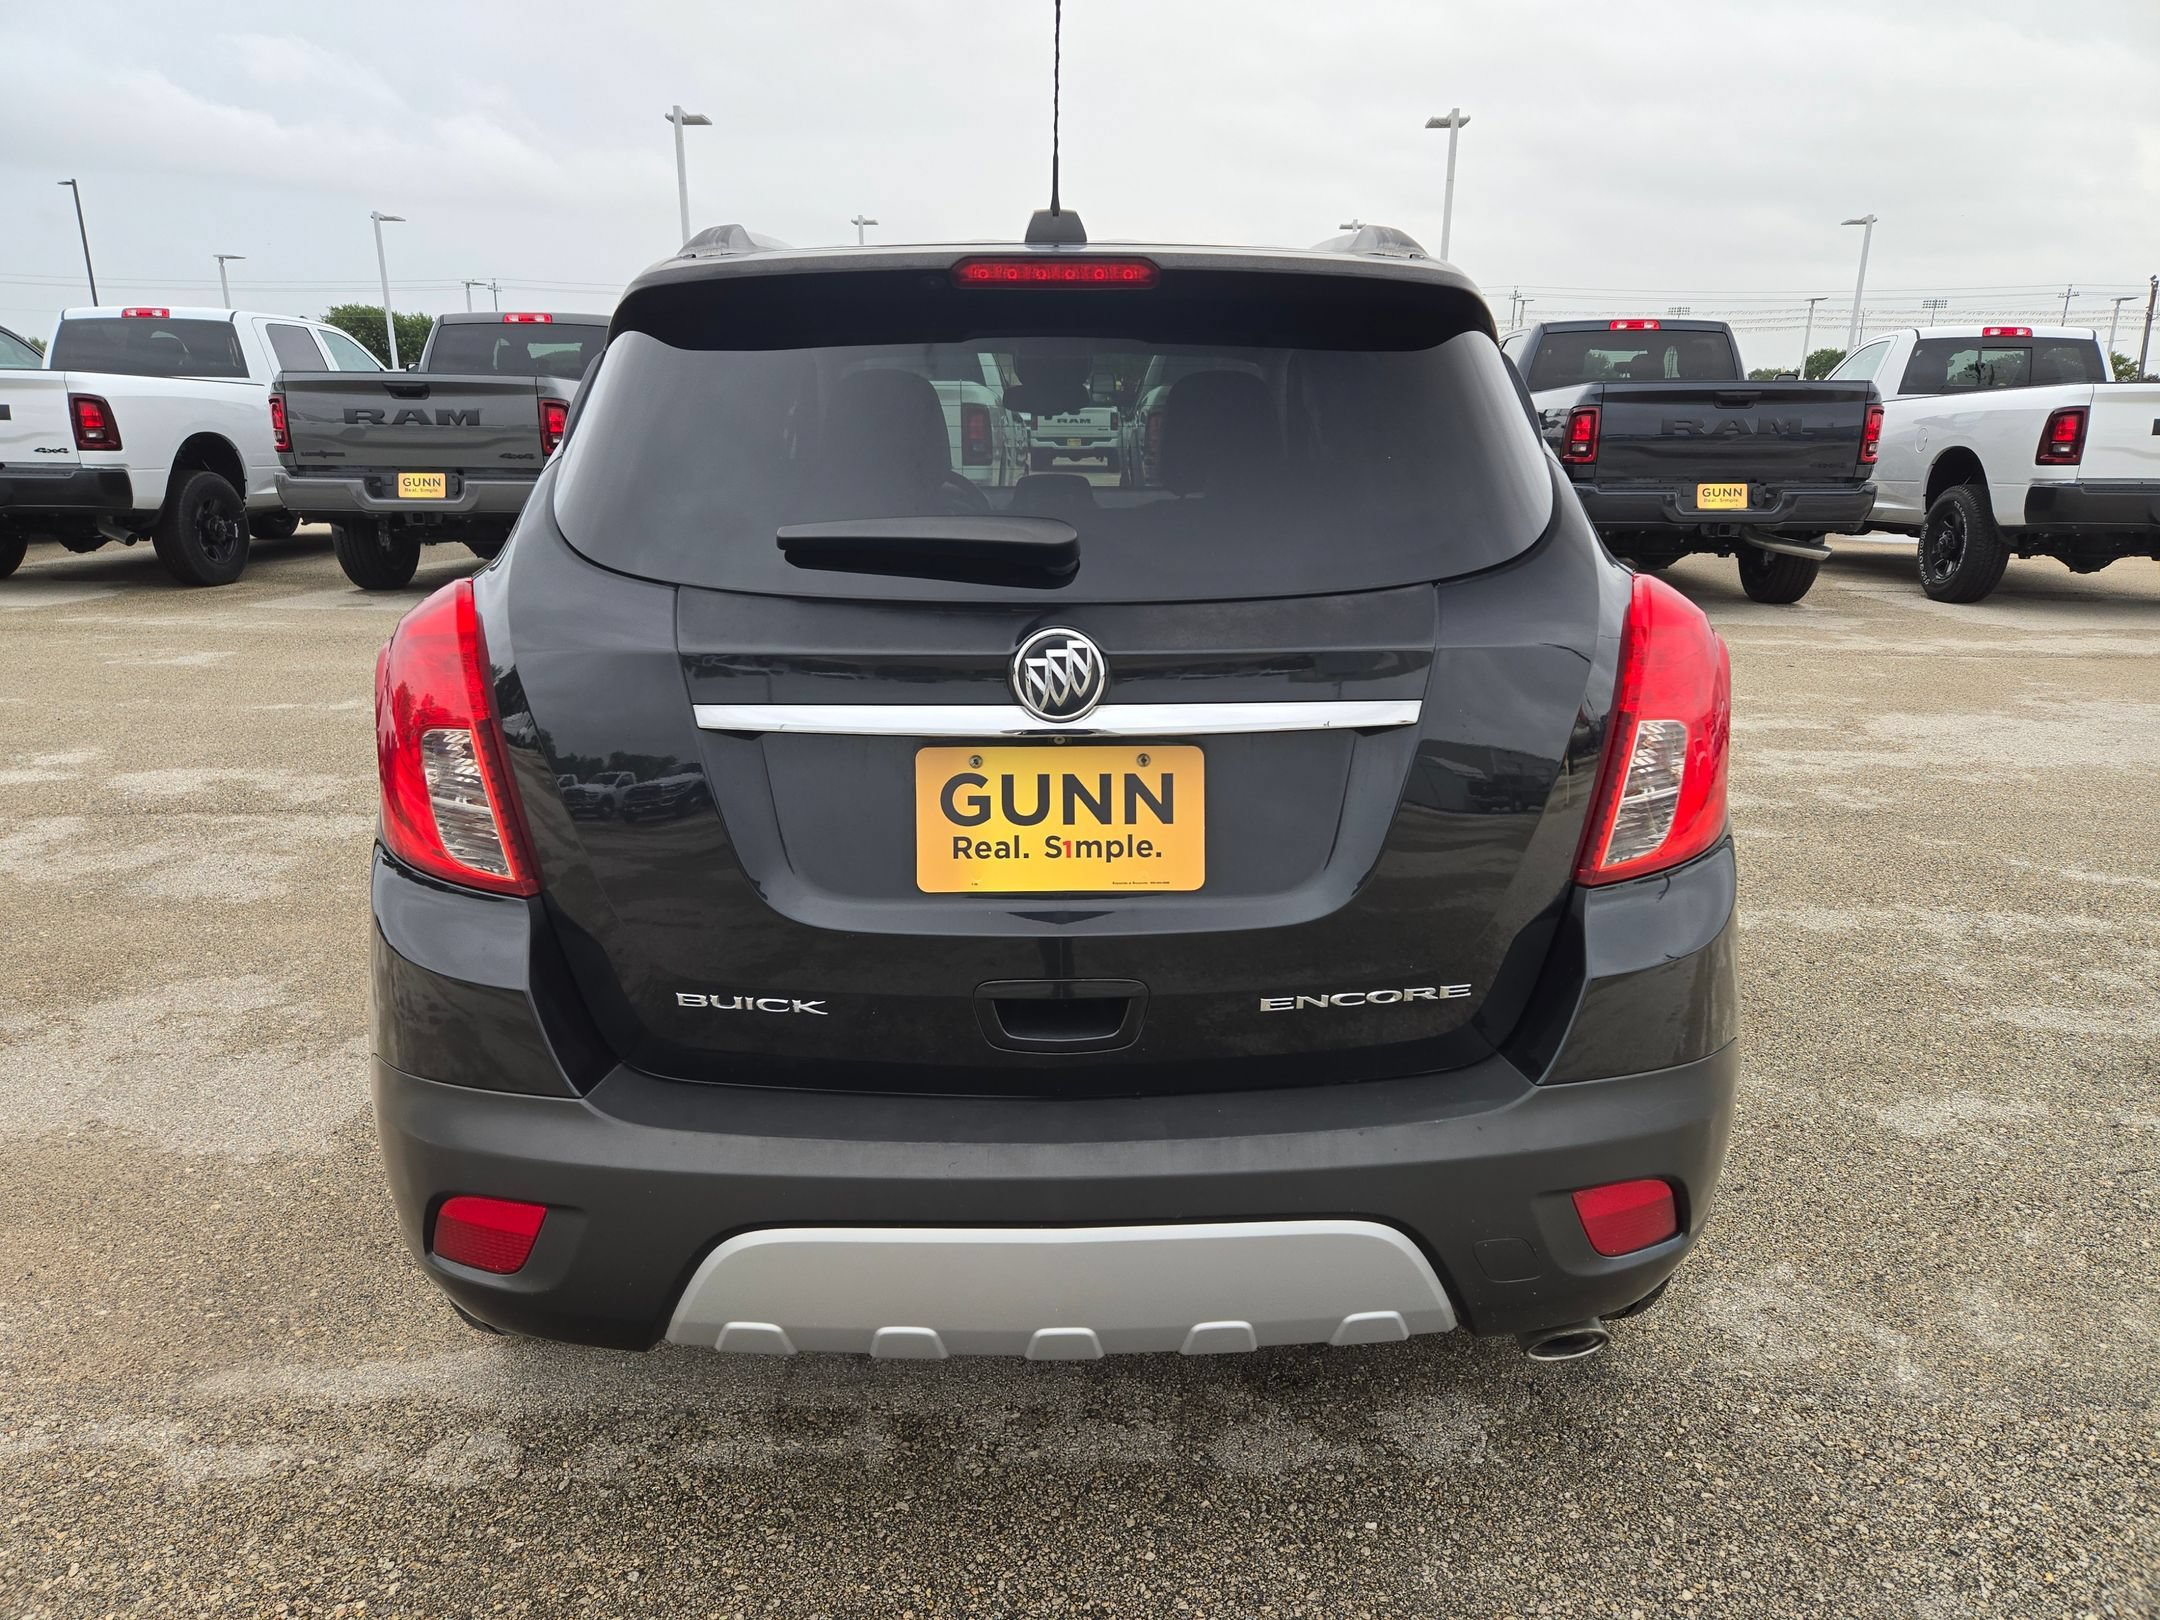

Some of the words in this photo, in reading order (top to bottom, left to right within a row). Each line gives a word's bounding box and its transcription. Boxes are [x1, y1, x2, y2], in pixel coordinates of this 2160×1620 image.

[343, 408, 481, 427] RAM
[1660, 417, 1803, 435] RAM
[402, 477, 441, 487] GUNN
[1702, 488, 1742, 497] GUNN
[940, 772, 1174, 827] GUNN
[953, 835, 1030, 859] Real.
[675, 992, 829, 1016] BUICK
[1259, 983, 1472, 1012] ENCORE
